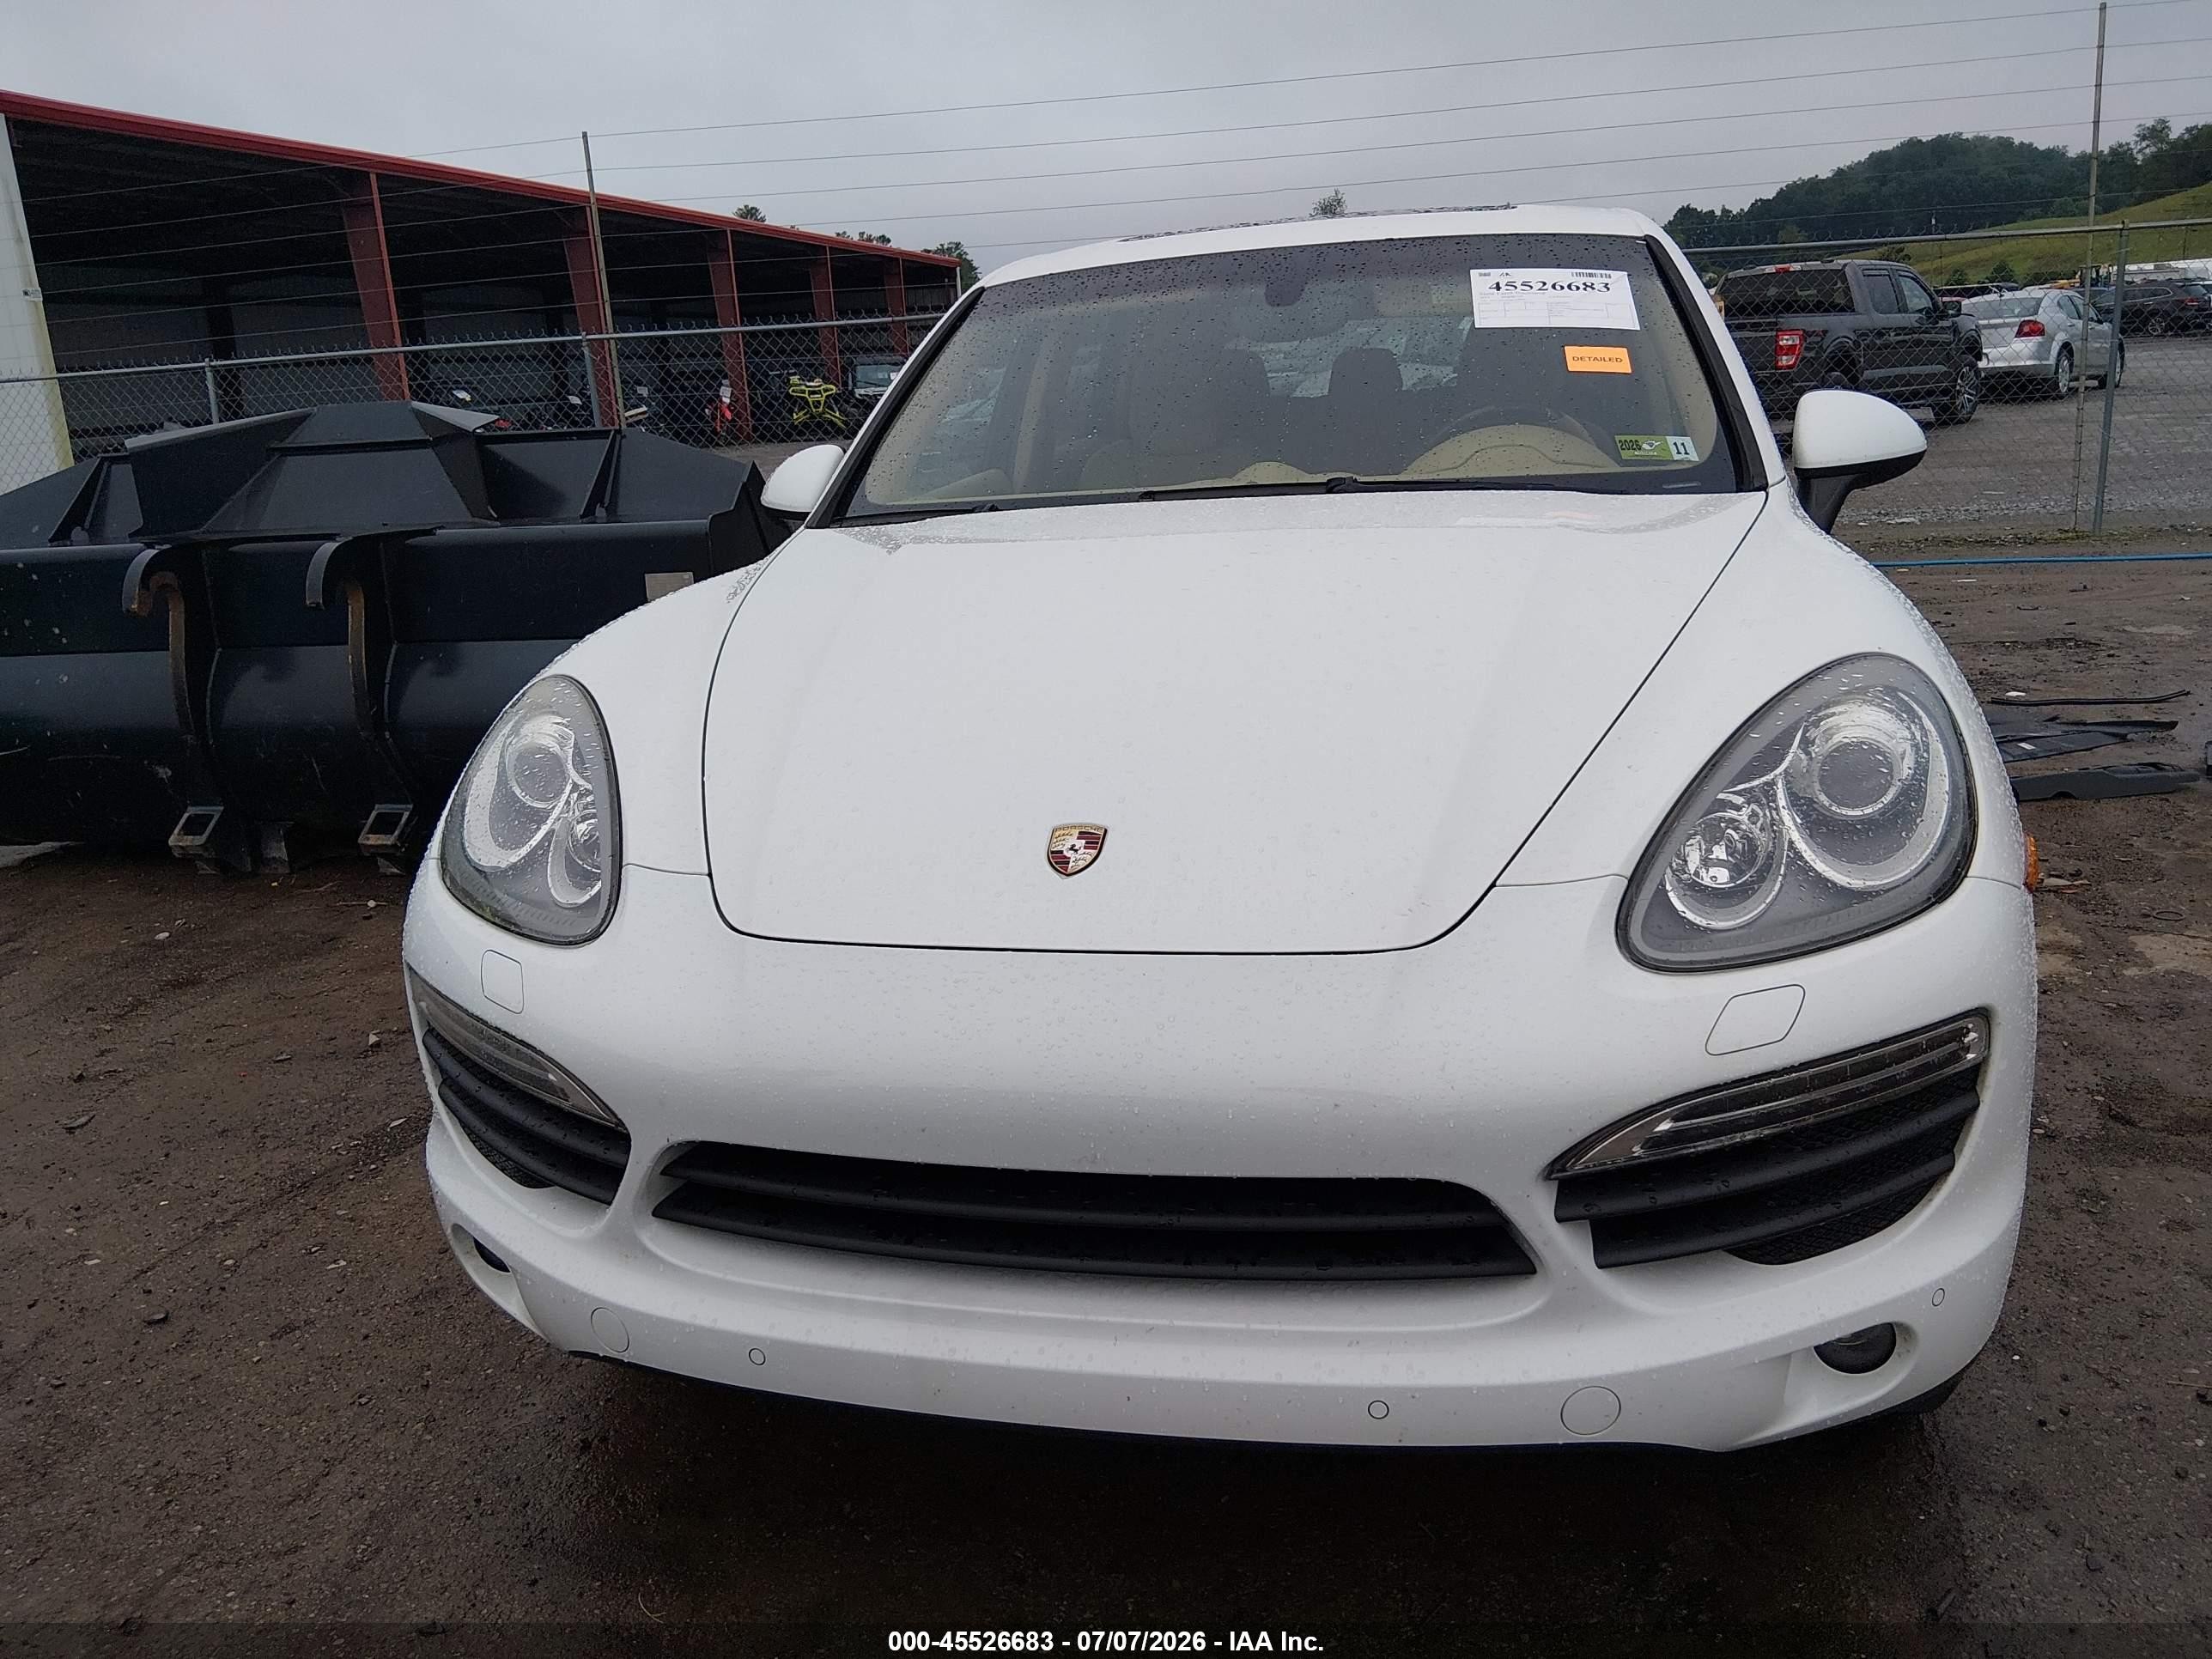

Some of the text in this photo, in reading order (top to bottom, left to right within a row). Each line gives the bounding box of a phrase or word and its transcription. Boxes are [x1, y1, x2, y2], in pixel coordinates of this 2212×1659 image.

[1488, 281, 1611, 293] 45526683
[1619, 439, 1690, 455] 2026 11
[1054, 825, 1103, 834] PORSCHE
